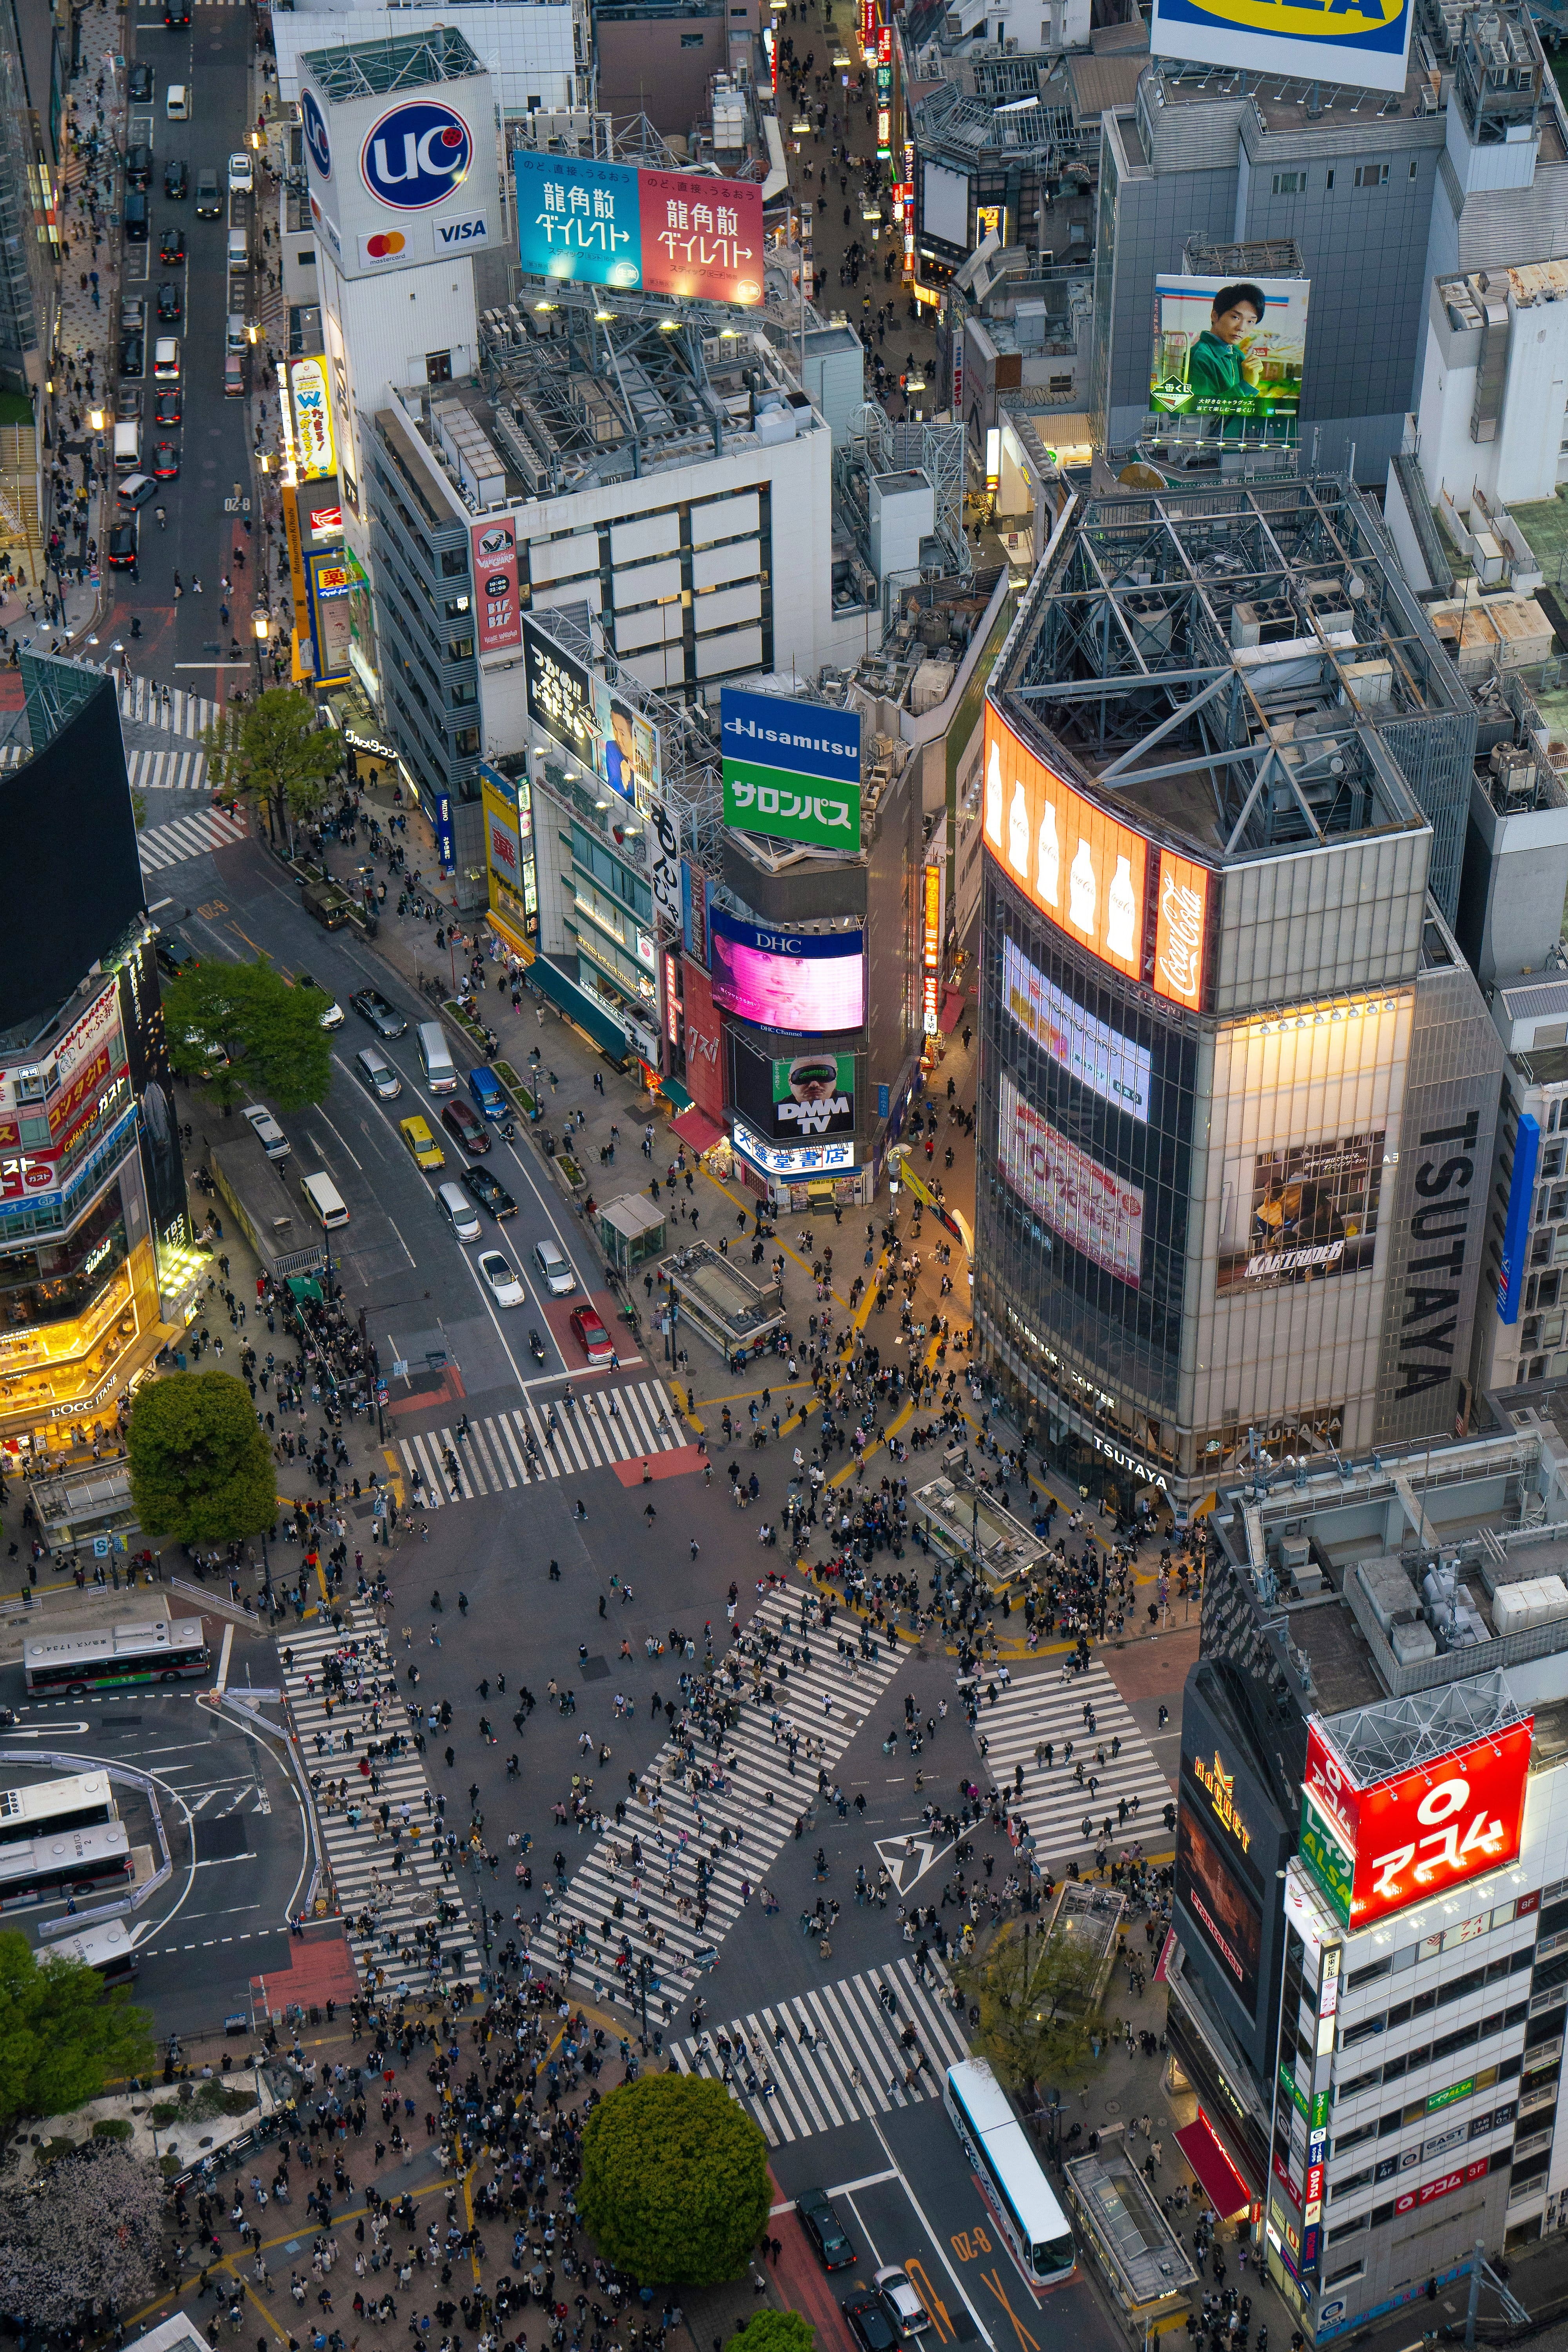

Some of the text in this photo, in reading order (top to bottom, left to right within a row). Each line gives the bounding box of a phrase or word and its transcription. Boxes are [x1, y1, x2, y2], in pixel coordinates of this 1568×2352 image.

[374, 125, 463, 183] UC
[524, 160, 630, 183] のど、直接、うるおう
[543, 181, 615, 220] 龍角散
[648, 177, 755, 201] のど、直接、うるおう
[667, 199, 739, 236] 龍角散
[437, 220, 486, 242] VISA
[535, 214, 630, 251] ダイレクト
[370, 254, 405, 265] mastercard
[657, 231, 752, 269] ダイレクト
[1154, 383, 1192, 393] 一番くじ
[476, 554, 515, 568] VANGUARD
[323, 568, 346, 586] 薬
[487, 599, 510, 615] B1F
[488, 612, 512, 628] B2F
[724, 717, 857, 757] Hisamitsu
[441, 799, 449, 821] MIZUHO
[732, 780, 851, 829] サロンパス
[756, 933, 801, 953] DHC
[760, 1025, 802, 1037] DHC Channel
[98, 1076, 125, 1115] ガスト
[778, 1096, 850, 1120] DMM
[797, 1115, 831, 1134] TV
[740, 1132, 845, 1169] 大盛堂書店
[29, 1174, 50, 1183] ガスト
[40, 1197, 53, 1205] 6F
[164, 1213, 184, 1242] TBS
[1244, 1240, 1346, 1277] KARTRIDER
[1395, 1111, 1480, 1401] TSUTAYA
[1093, 1435, 1167, 1491] TSUTAYA
[46, 1644, 71, 1652] 1734
[1195, 1755, 1251, 1854] MAGNET
[1307, 1802, 1352, 1877] レイク
[1372, 1810, 1504, 1893] アコム
[1303, 1832, 1349, 1909] ALSA
[1521, 1897, 1534, 1910] 8F
[1426, 2128, 1465, 2149] EAST
[1468, 2162, 1485, 2176] 3F
[1421, 2175, 1461, 2199] アコム
